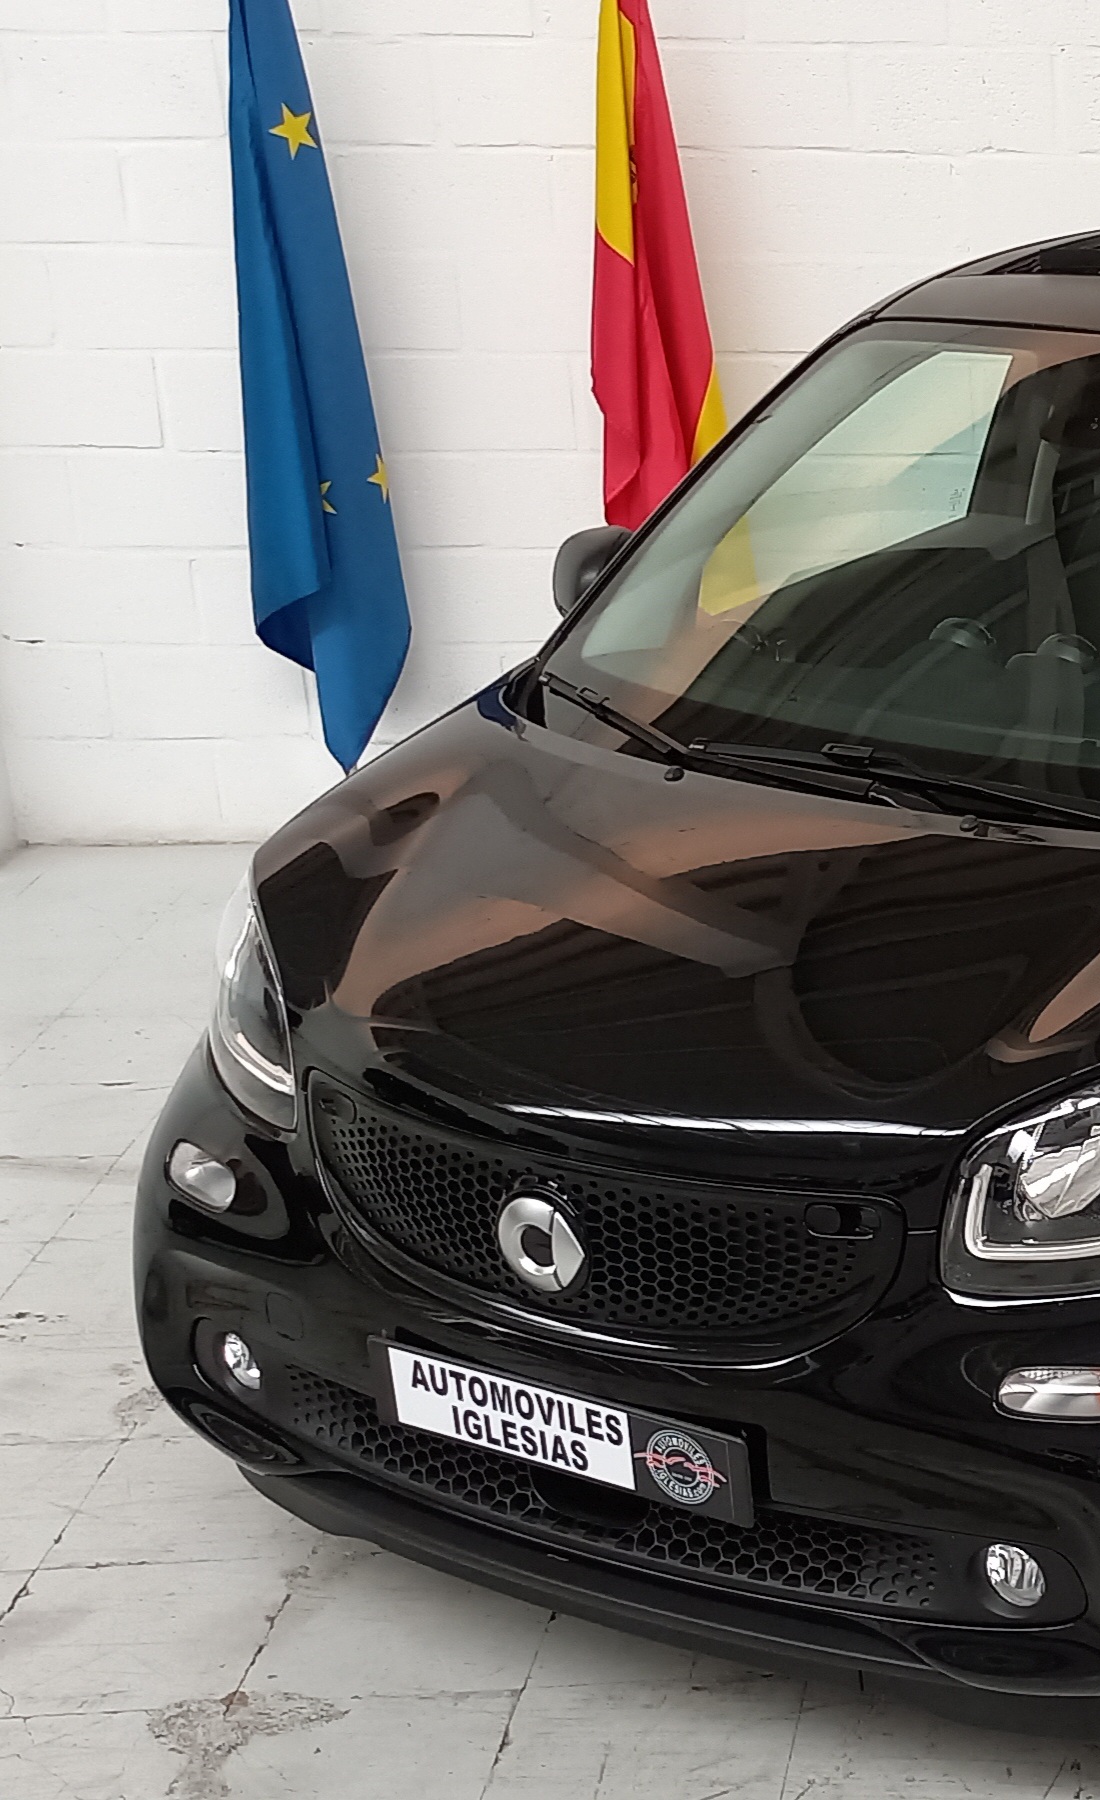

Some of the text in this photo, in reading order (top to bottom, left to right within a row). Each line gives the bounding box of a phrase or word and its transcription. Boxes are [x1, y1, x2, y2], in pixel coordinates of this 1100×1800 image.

[411, 1360, 624, 1447] AUTOMOVILES
[452, 1405, 589, 1472] IGLESIAS
[655, 1436, 705, 1465] AUTOMOVILES
